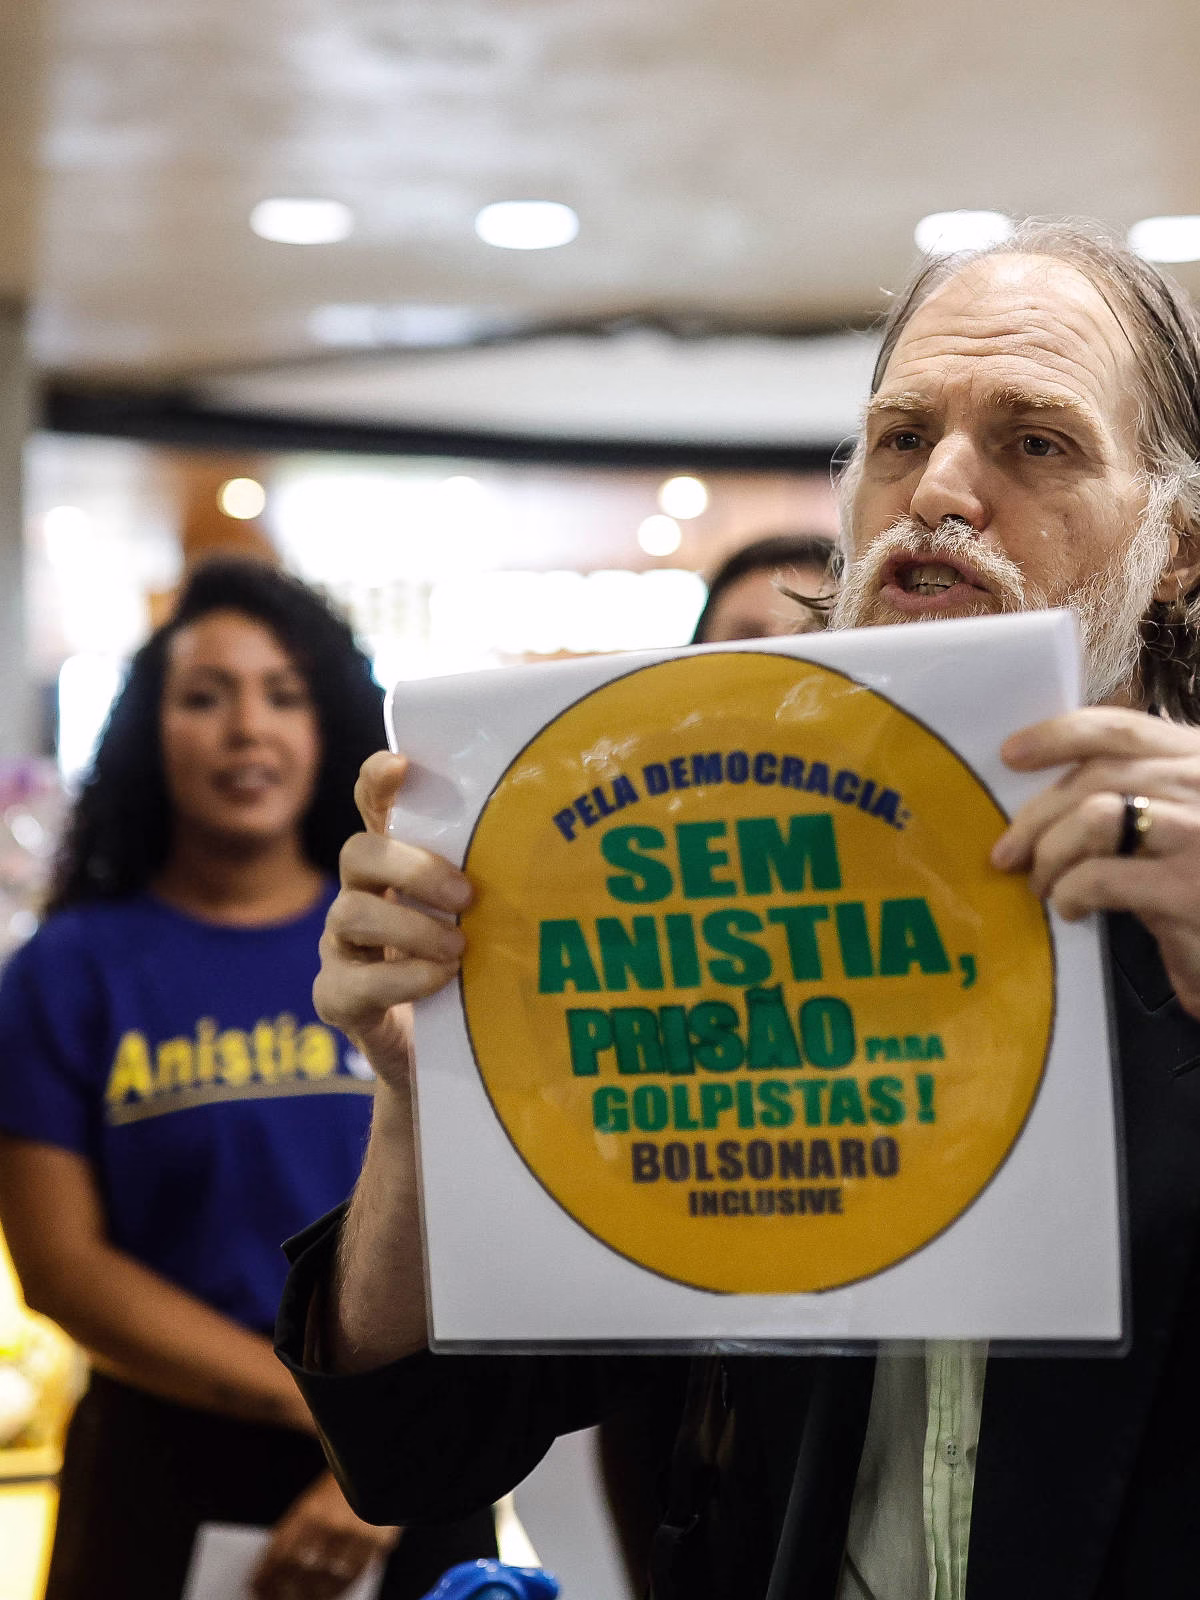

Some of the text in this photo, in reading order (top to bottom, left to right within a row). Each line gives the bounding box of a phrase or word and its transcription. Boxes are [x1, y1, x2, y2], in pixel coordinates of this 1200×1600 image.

[552, 751, 912, 842] PELA DEMOCRACIA:
[600, 813, 842, 905] SEM
[538, 897, 977, 993] ANISTIA,
[105, 1011, 338, 1104] Anistia
[566, 984, 947, 1077] PRISÃO PARA
[631, 1137, 900, 1183] BOLSONARO
[688, 1187, 845, 1217] INCLUSIVE
